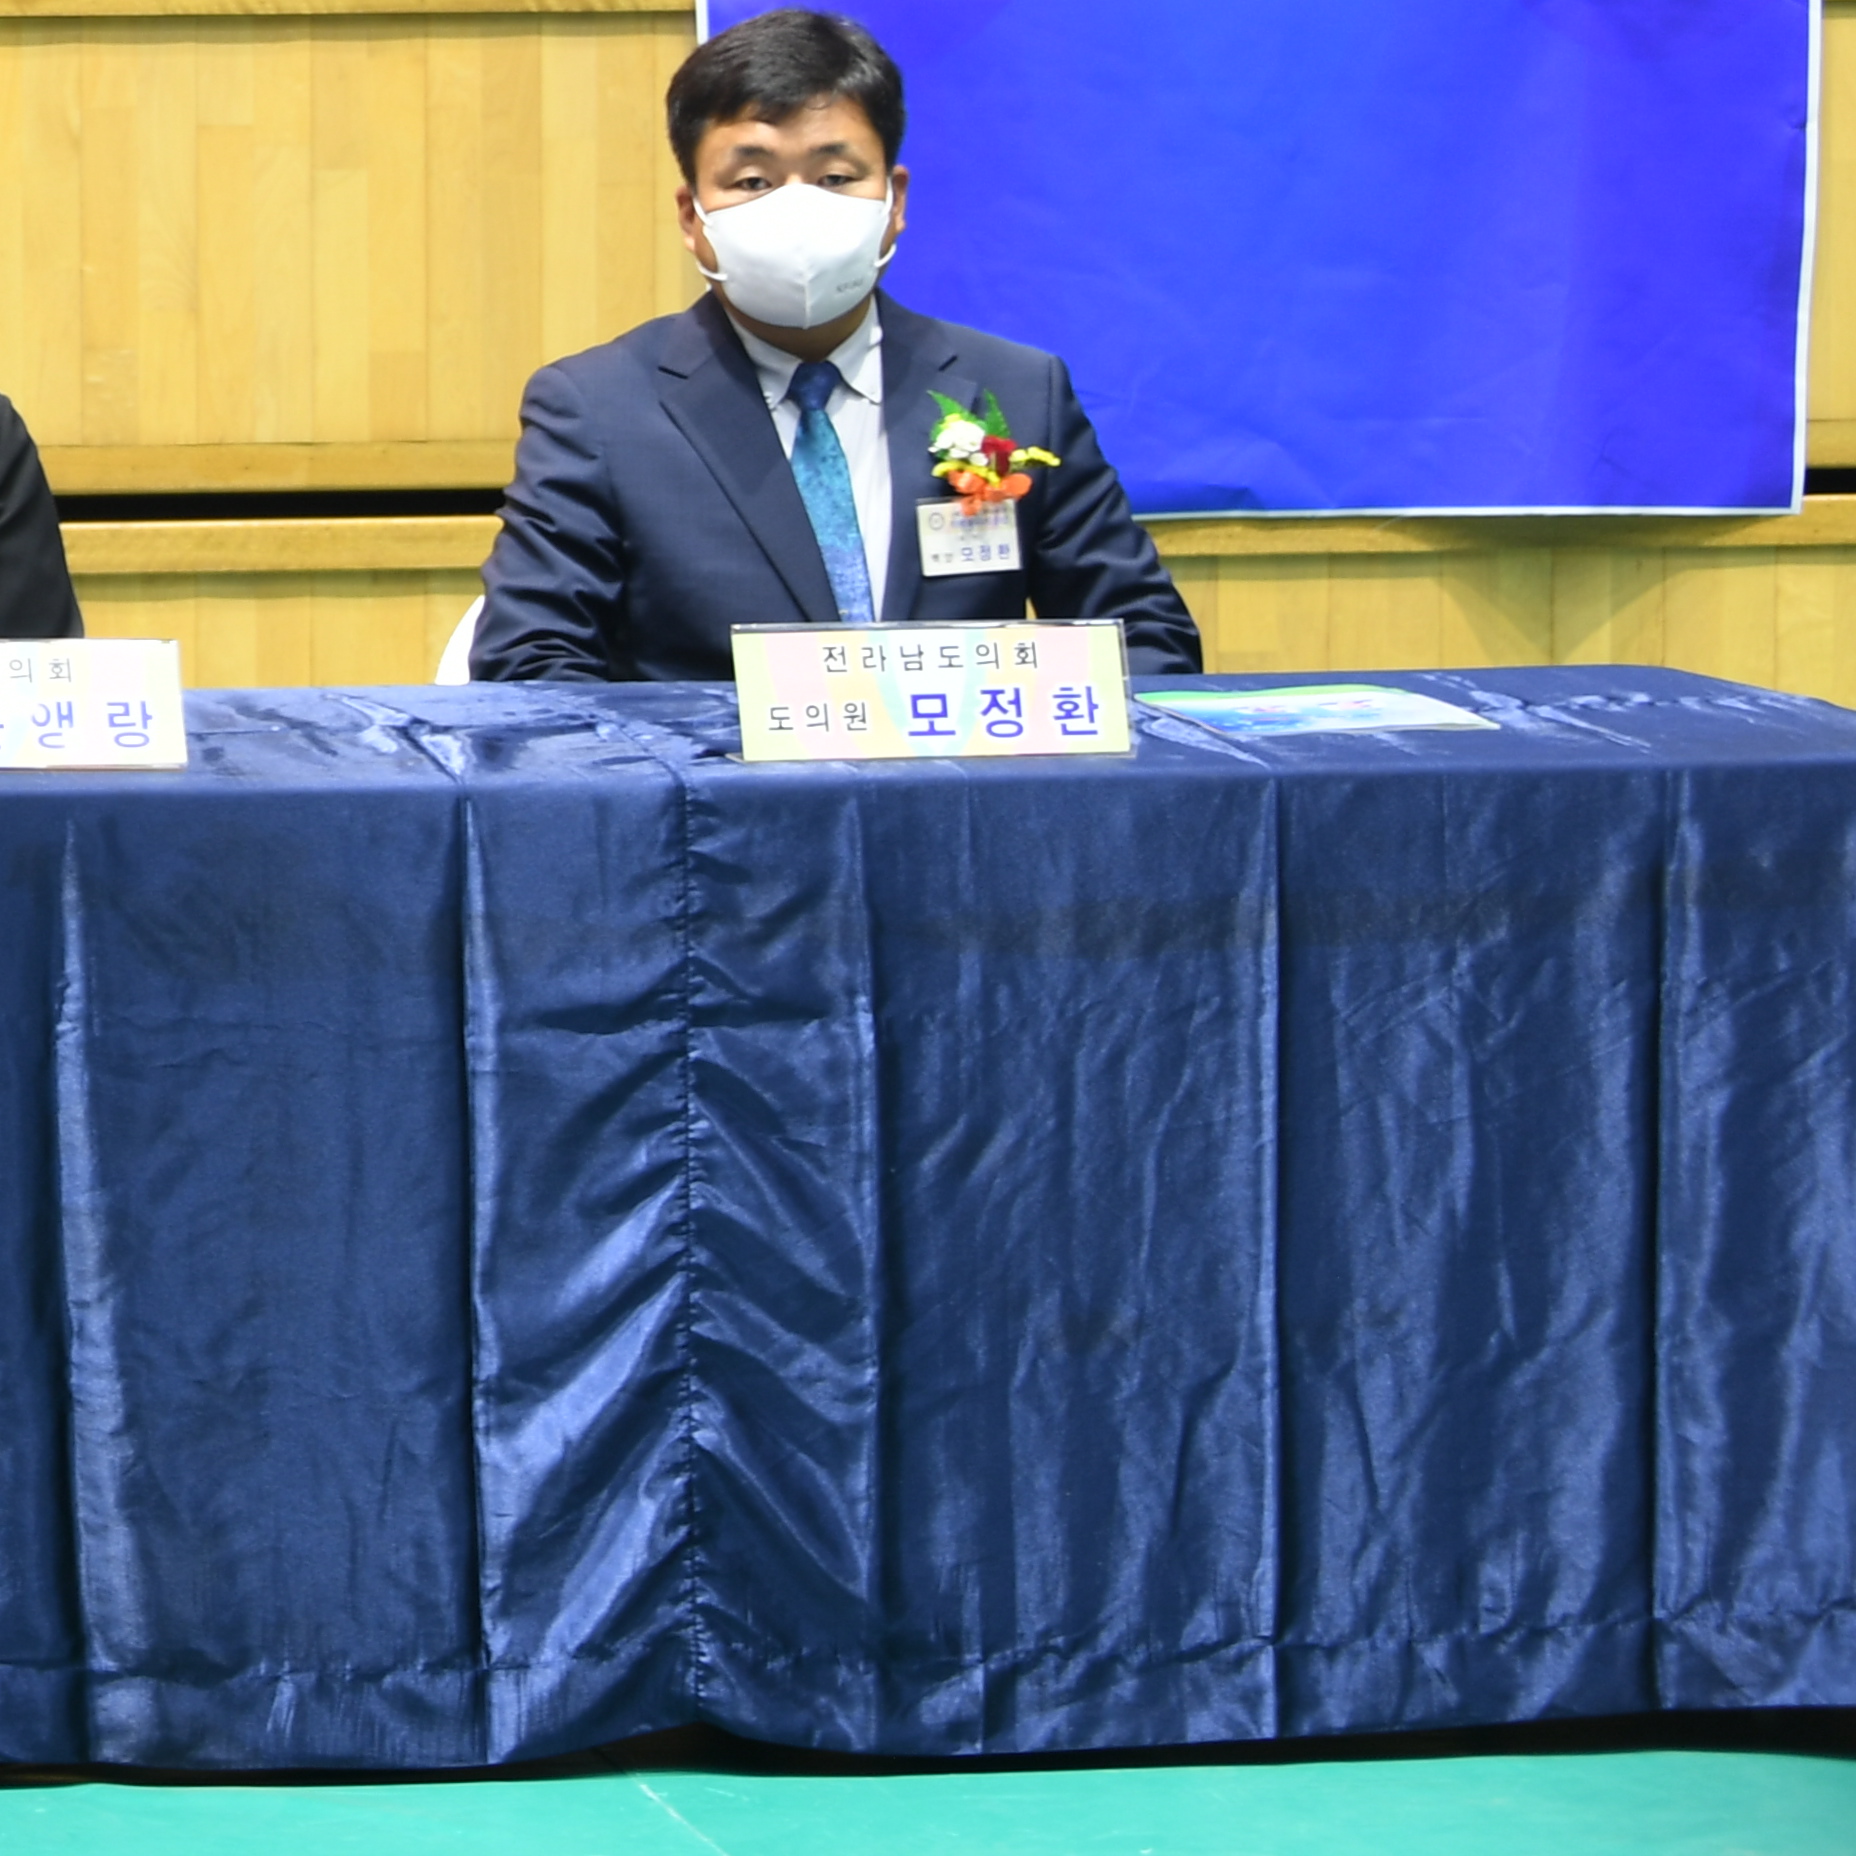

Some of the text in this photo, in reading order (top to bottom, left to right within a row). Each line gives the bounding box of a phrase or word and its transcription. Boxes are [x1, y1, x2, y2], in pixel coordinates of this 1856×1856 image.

[822, 641, 1039, 673] 전라남도의회
[767, 684, 1100, 738] 도의원 모정환
